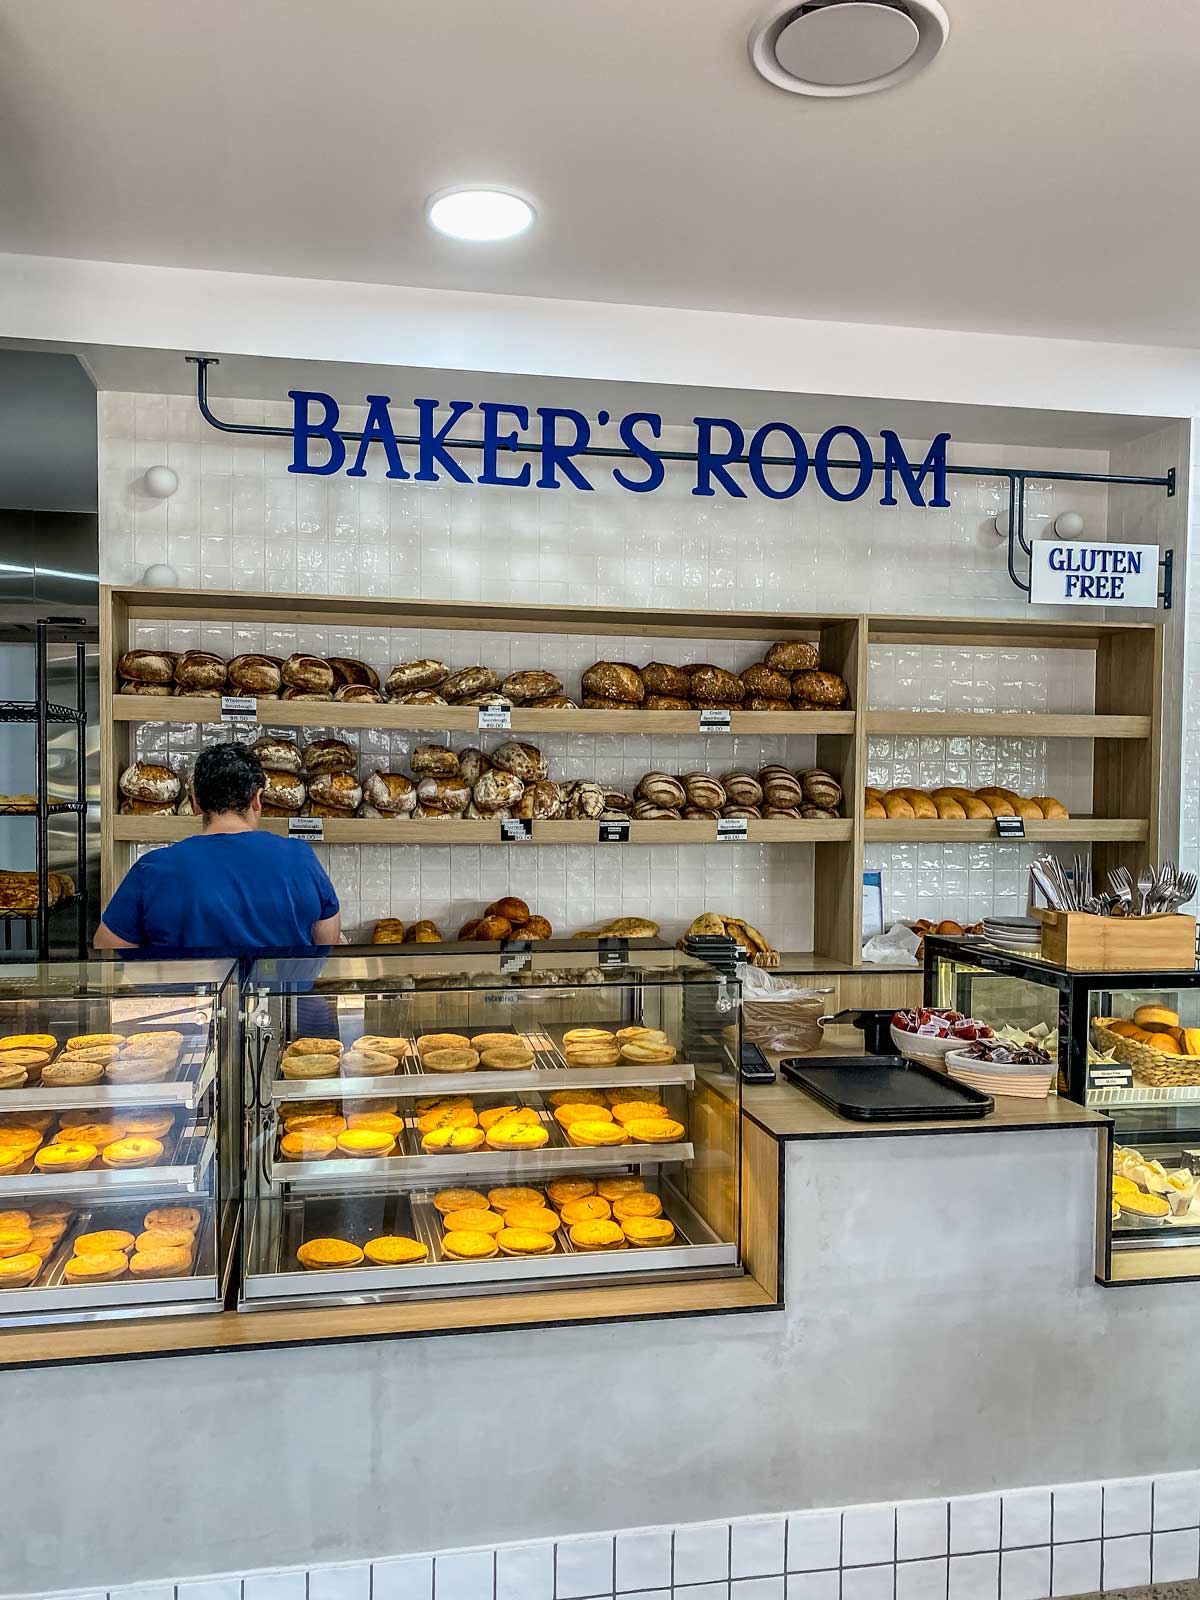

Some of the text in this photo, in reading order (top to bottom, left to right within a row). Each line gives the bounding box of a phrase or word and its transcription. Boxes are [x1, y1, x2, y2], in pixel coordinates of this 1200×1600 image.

[287, 390, 952, 508] BAKER'S ROOM
[1048, 547, 1143, 574] GLUTEN
[1065, 574, 1125, 600] FREE
